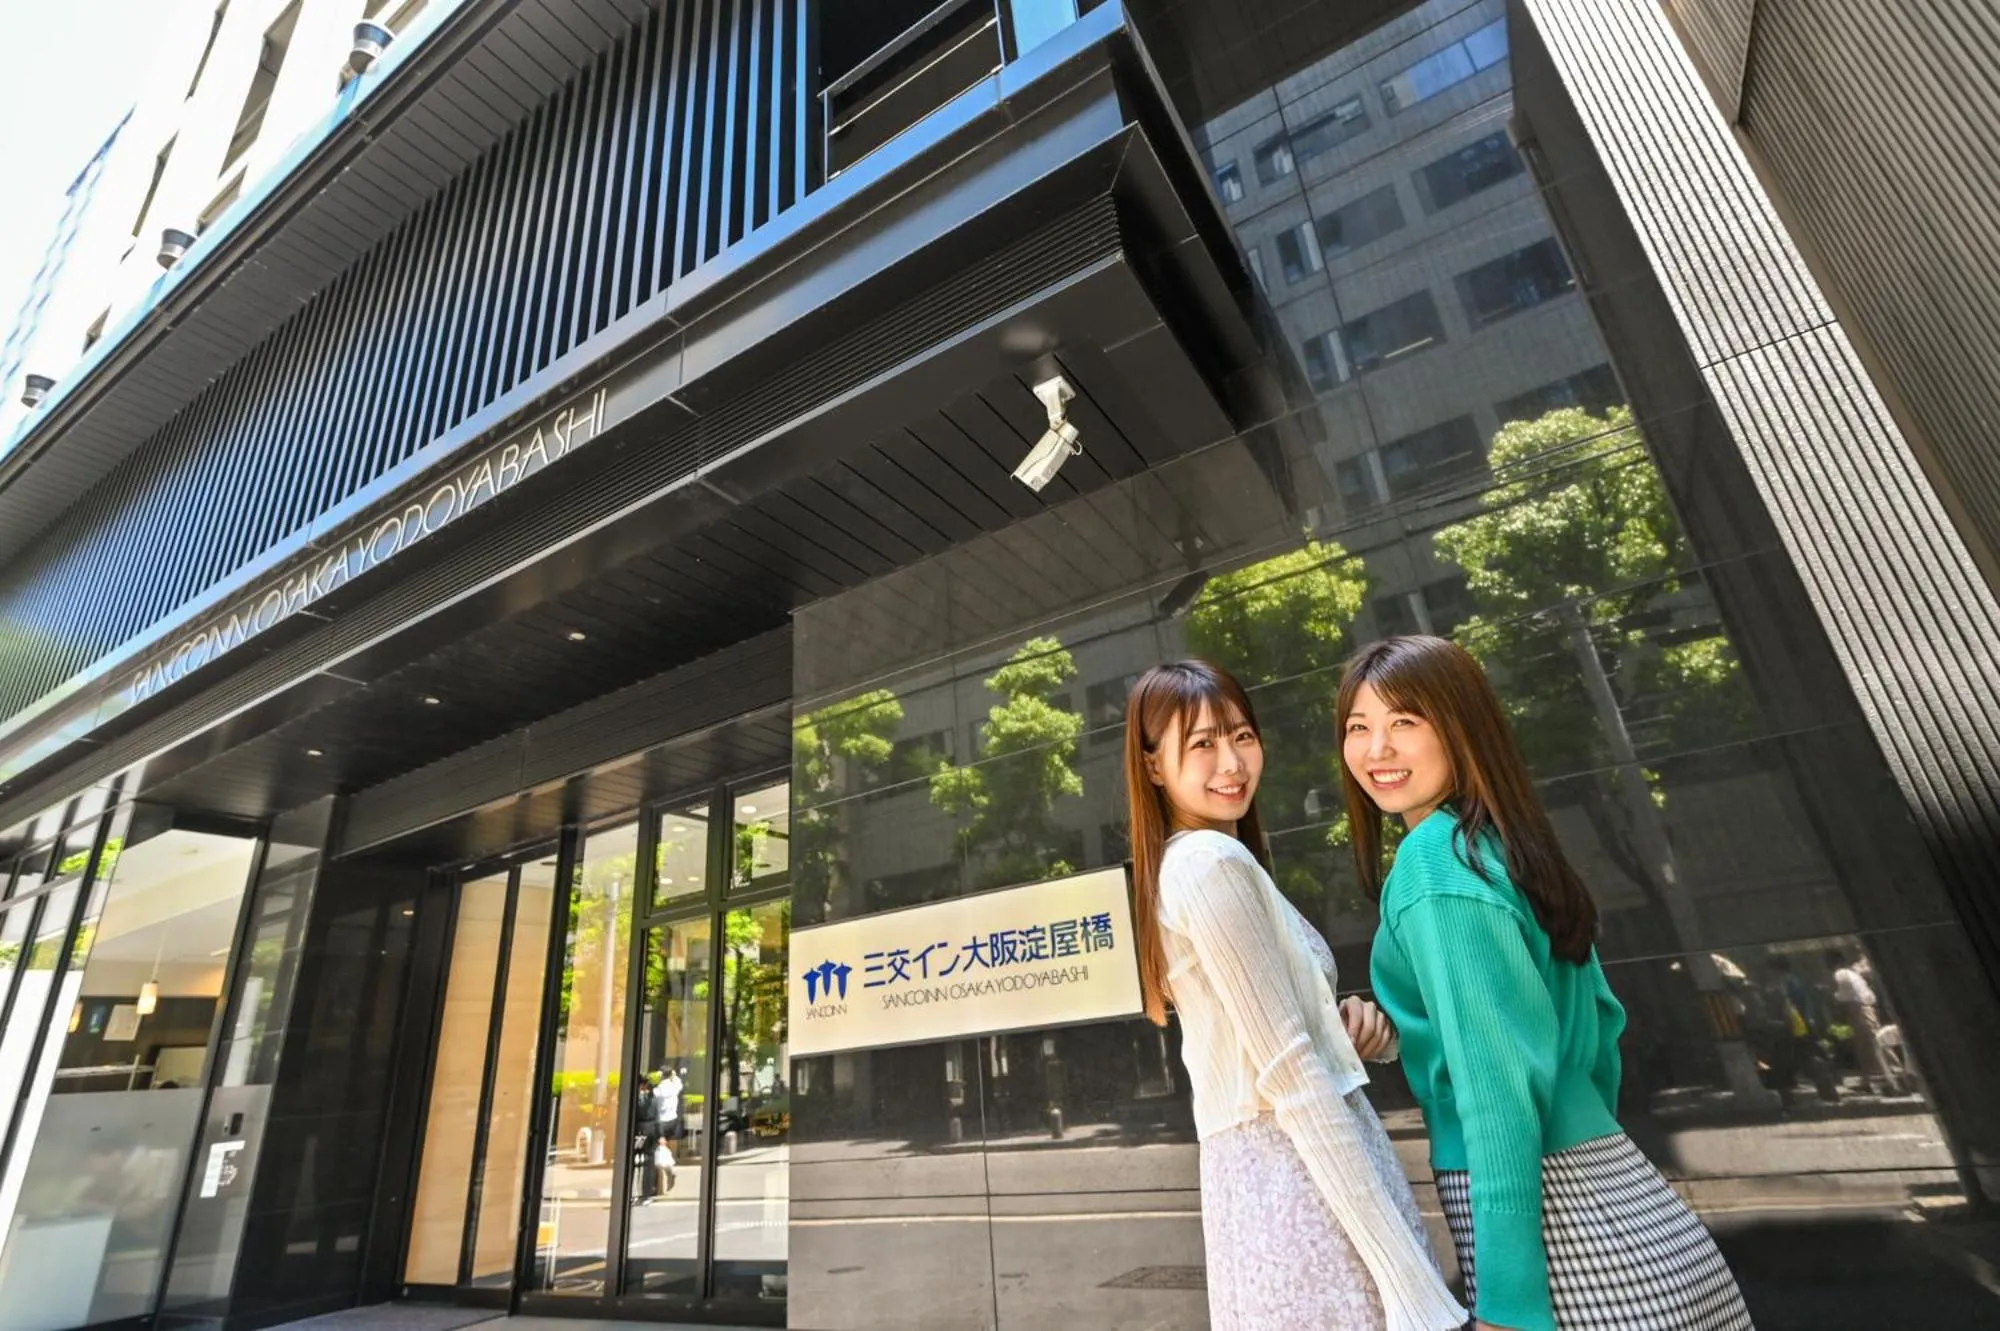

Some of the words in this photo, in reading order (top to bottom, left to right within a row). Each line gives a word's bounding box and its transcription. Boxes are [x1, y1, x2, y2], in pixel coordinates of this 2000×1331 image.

[254, 546, 349, 632] OSAKA
[358, 388, 606, 573] YODOYABASHI
[863, 912, 1114, 988] 三交イン大阪淀屋橋
[949, 978, 996, 1001] OSAKA
[994, 965, 1089, 992] YODOYABASHI
